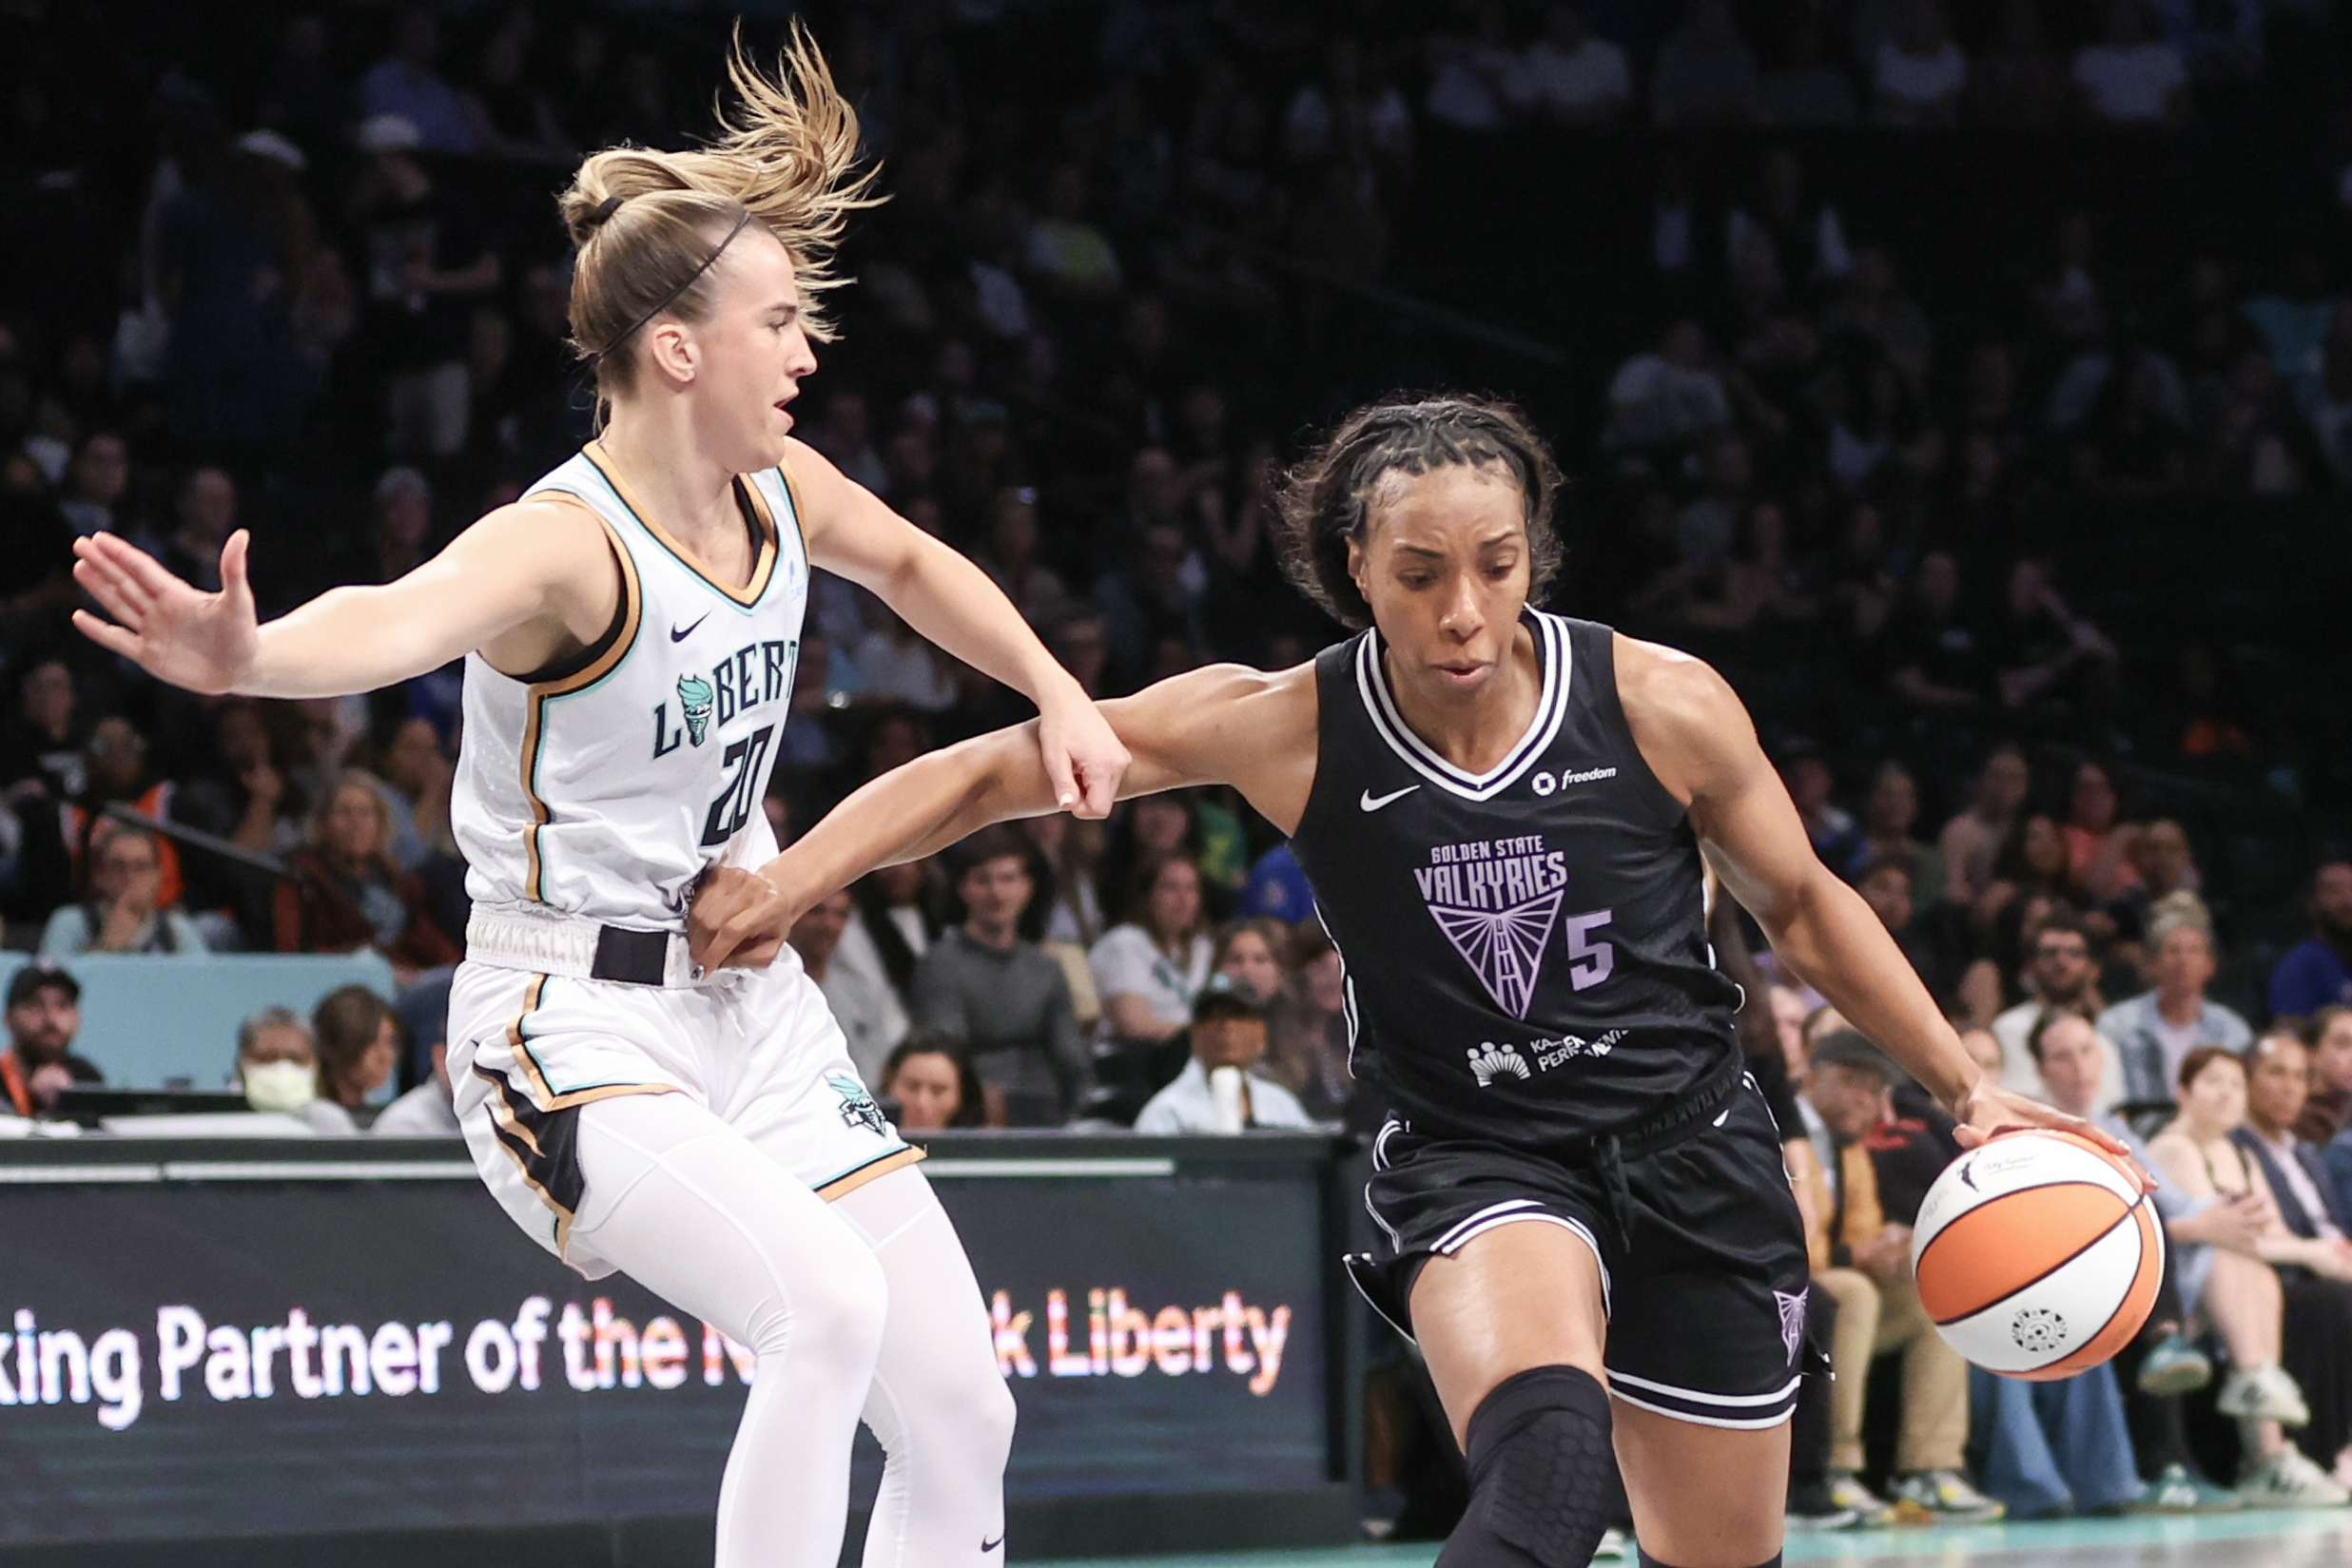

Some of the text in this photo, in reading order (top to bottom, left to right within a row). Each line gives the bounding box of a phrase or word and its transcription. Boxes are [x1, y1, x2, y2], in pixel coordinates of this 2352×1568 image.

[699, 723, 776, 848] 20
[1561, 767, 1617, 790] freedom
[1413, 851, 1568, 910] VALKYRIES
[1430, 835, 1545, 864] GOLDEN STATE
[1565, 909, 1614, 992] 5
[158, 1305, 453, 1401] Partner
[465, 1295, 552, 1394] of
[560, 1296, 689, 1390] the
[1047, 1287, 1291, 1397] Liberty
